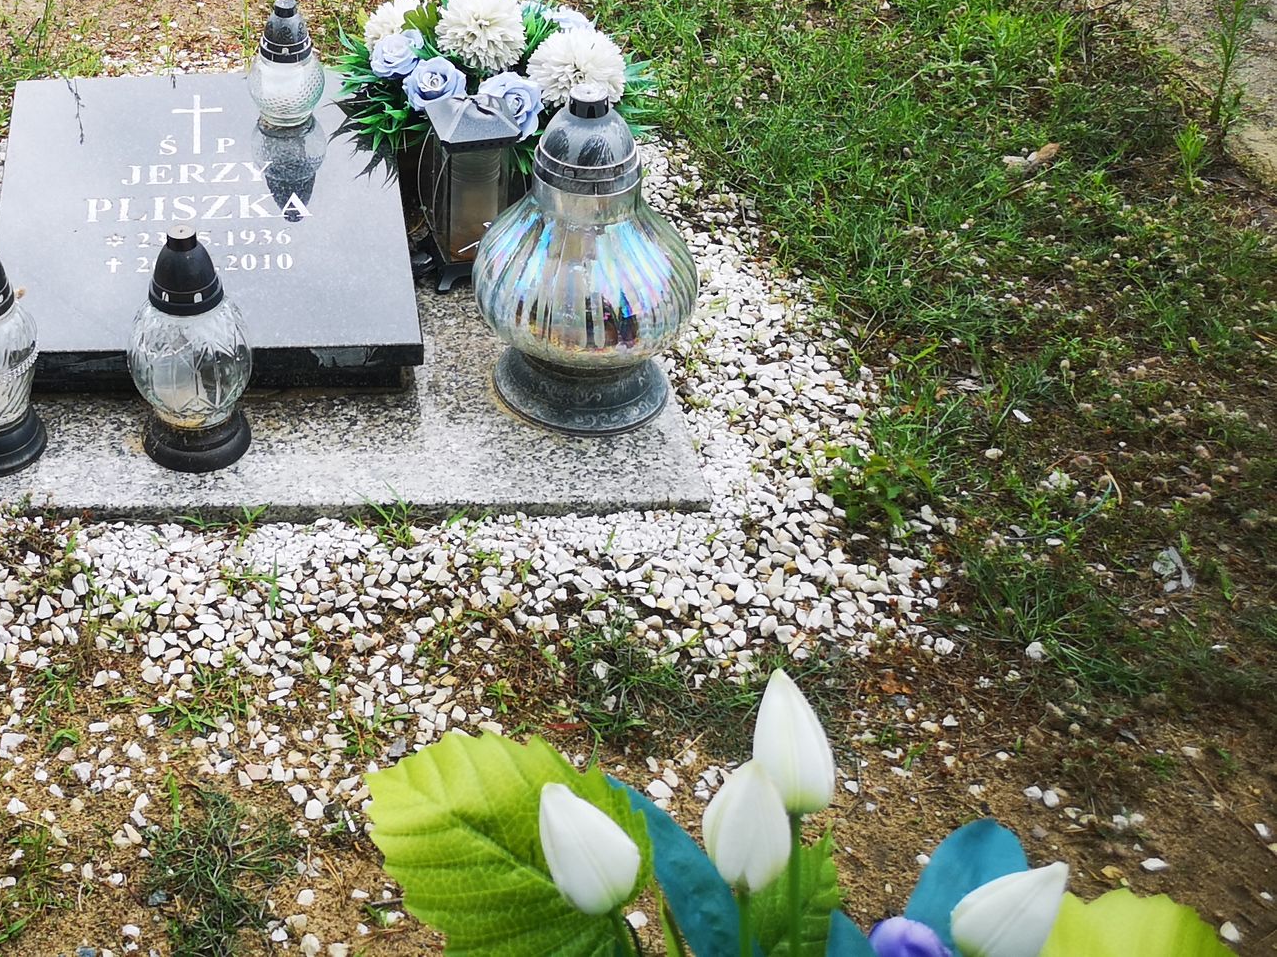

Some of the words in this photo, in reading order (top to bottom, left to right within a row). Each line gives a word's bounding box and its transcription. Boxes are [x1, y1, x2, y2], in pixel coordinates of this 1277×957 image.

[158, 135, 178, 156] Ś
[217, 137, 236, 154] P
[121, 161, 273, 186] JERZY
[86, 192, 313, 223] PLISZKA
[136, 228, 292, 249] 235.1936
[135, 253, 294, 273] 2.2010
